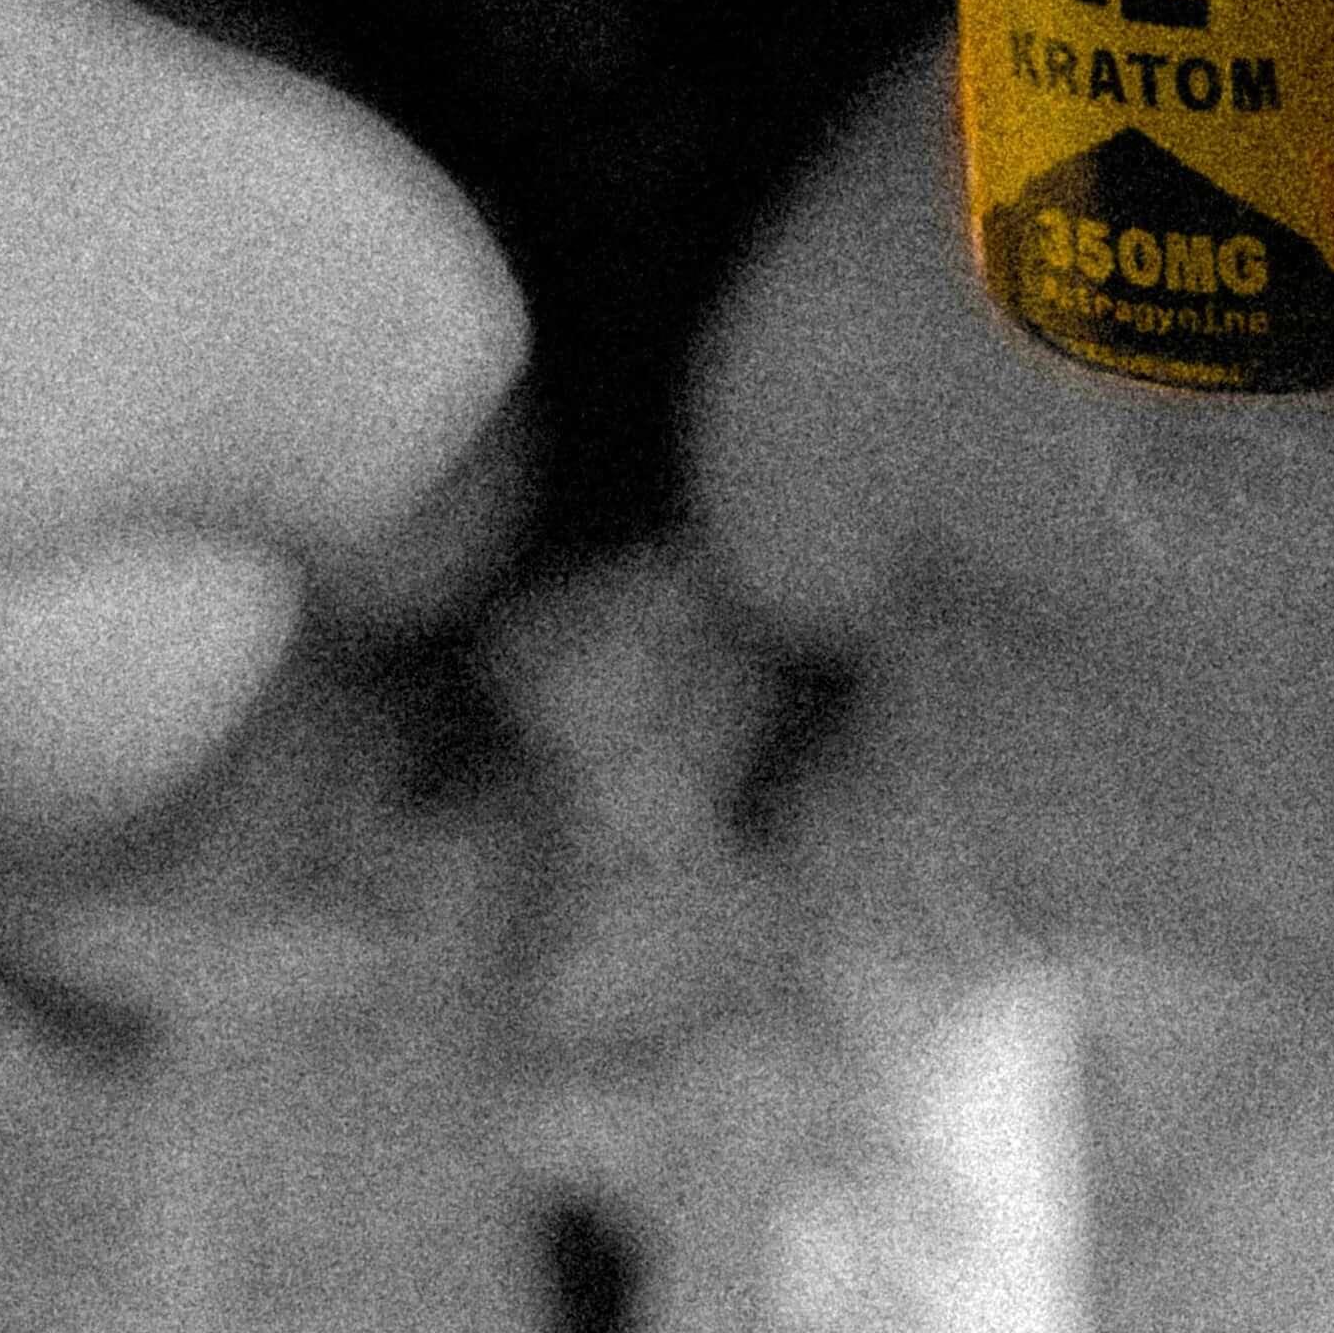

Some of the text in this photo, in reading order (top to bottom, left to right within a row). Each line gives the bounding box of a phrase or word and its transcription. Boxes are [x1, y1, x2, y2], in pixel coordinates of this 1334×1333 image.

[1009, 29, 1283, 113] KRATOM
[1034, 206, 1272, 298] 350MG
[1037, 273, 1273, 336] tragynine
